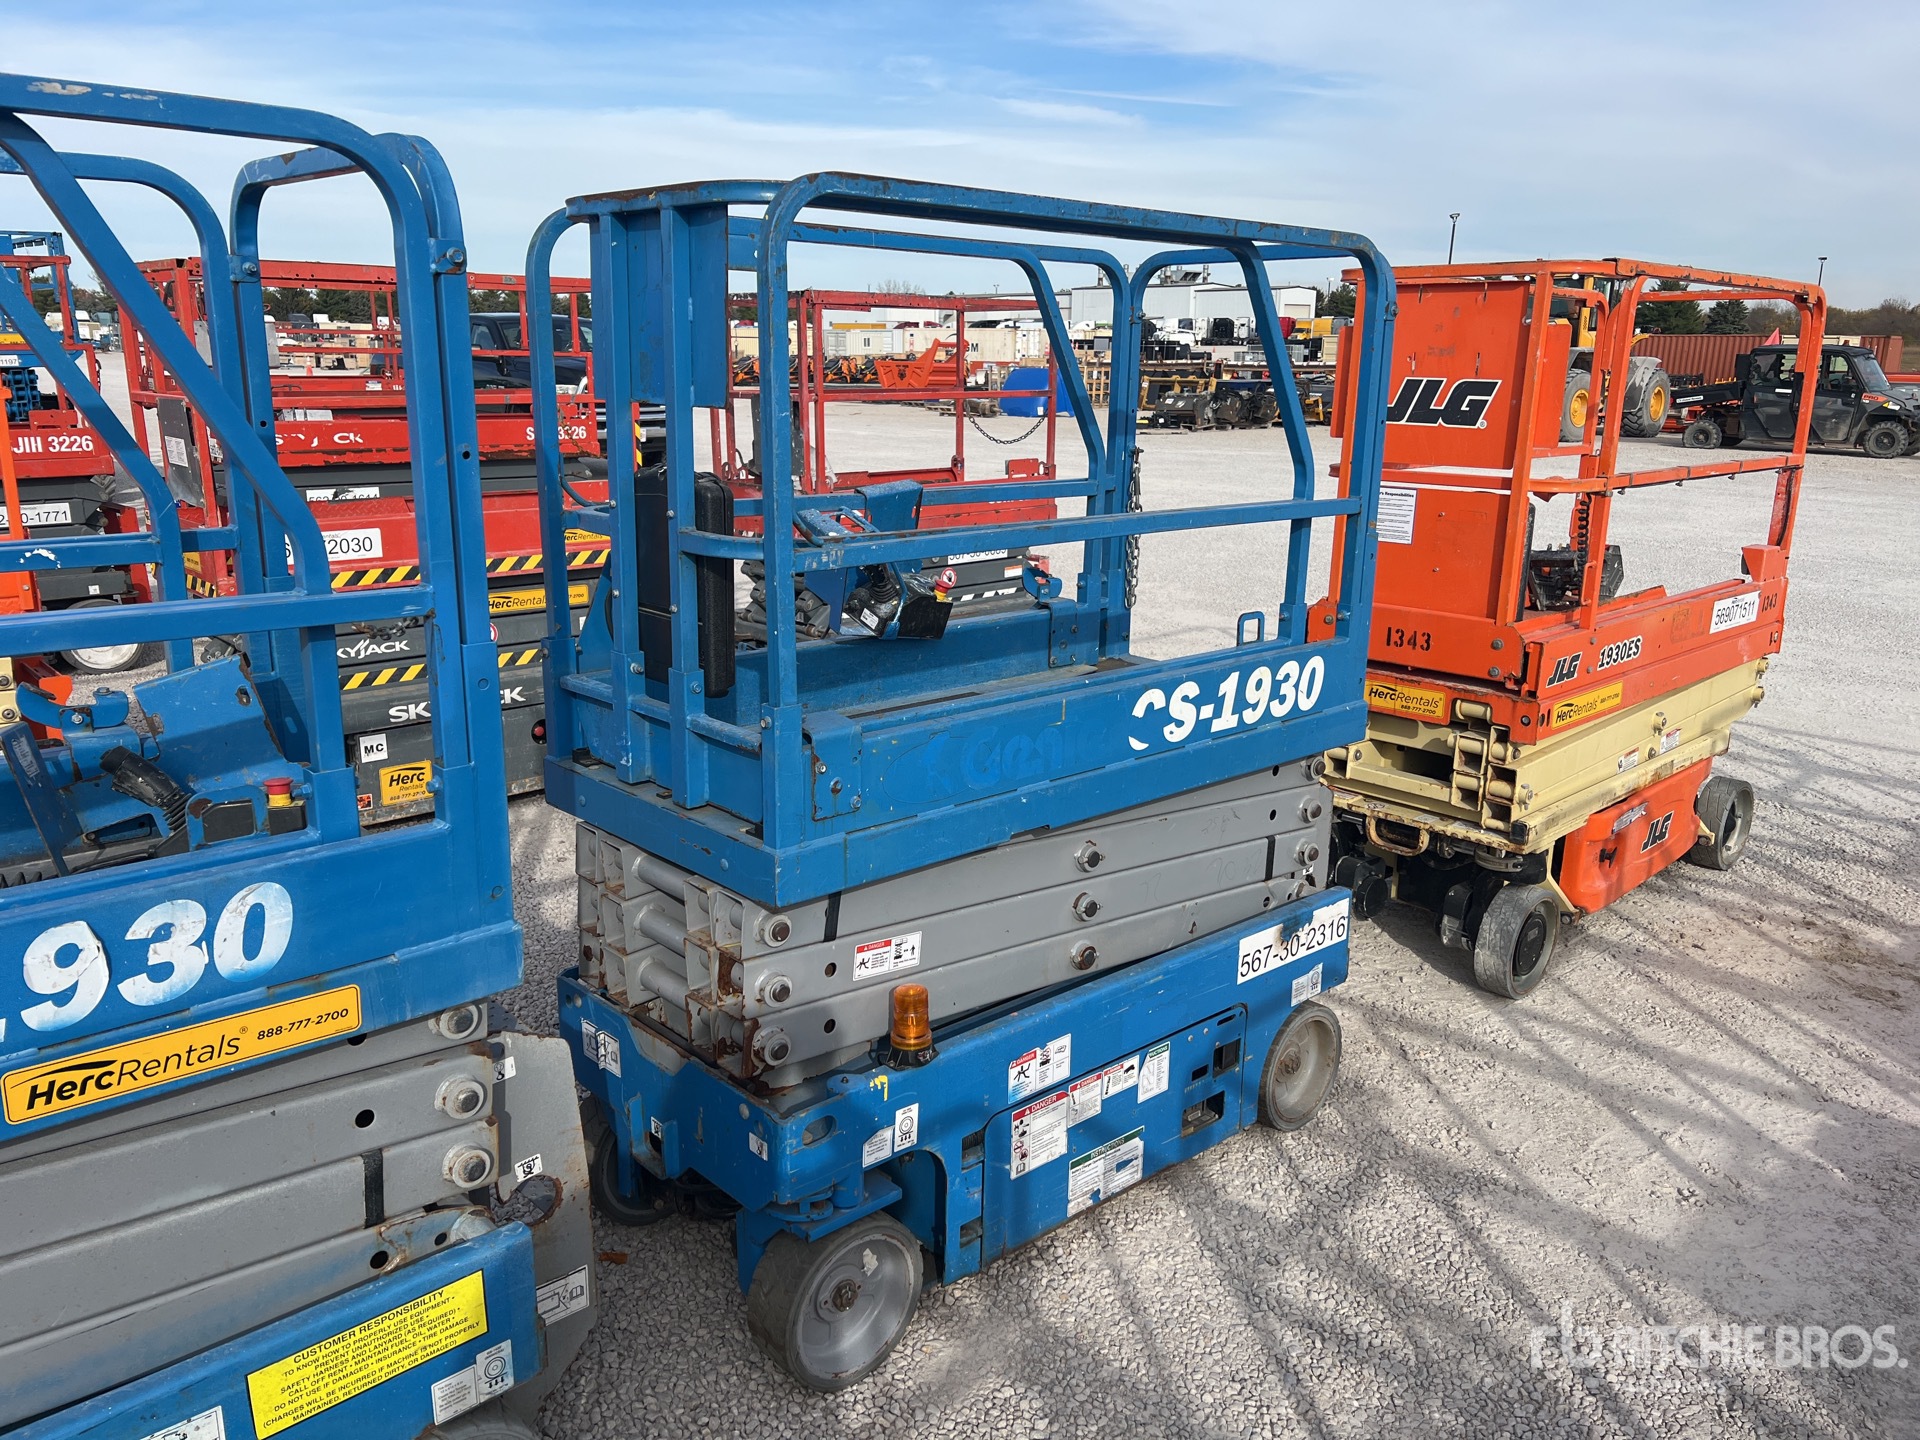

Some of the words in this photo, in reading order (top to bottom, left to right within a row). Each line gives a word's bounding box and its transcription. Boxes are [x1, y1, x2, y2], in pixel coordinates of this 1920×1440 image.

[1386, 377, 1501, 428] JLG
[48, 435, 94, 452] 3226
[488, 596, 546, 610] HercRental
[1714, 600, 1756, 626] 569071511
[1386, 627, 1432, 651] 1343
[1546, 652, 1582, 688] JLG
[1598, 636, 1642, 670] 1930ES
[388, 772, 426, 787] Herc
[1640, 811, 1674, 854] JLG
[0, 882, 293, 1042] 930
[1240, 916, 1346, 978] 567-30-2316
[257, 1008, 348, 1040] 888-777-2700
[1031, 1096, 1057, 1112] DANGER
[280, 1376, 310, 1394] SAFETY
[313, 1358, 350, 1378] HARNESS
[352, 1350, 366, 1361] AND
[368, 1334, 402, 1353] LANYARD
[404, 1327, 416, 1338] (AS
[418, 1308, 456, 1329] REQUIRED)
[284, 1370, 294, 1378] TO
[296, 1357, 320, 1372] KNOW
[322, 1348, 340, 1360] HOW
[342, 1343, 351, 1352] TO
[354, 1324, 392, 1346] PROPERLY
[394, 1317, 408, 1327] USE
[410, 1298, 450, 1320] EQUIPMENT
[294, 1330, 356, 1364] CUSTOMER
[359, 1290, 444, 1334] RESPONSIBILITY
[314, 1350, 349, 1370] PREVENT
[352, 1324, 408, 1356] UNAUTHORIZED
[410, 1316, 424, 1326] USE
[263, 1405, 305, 1428] (CHARGES
[306, 1396, 324, 1408] WILL
[326, 1389, 336, 1398] BE
[338, 1370, 376, 1392] INCURRED
[378, 1364, 385, 1372] IF
[386, 1350, 420, 1369] MACHINE
[428, 1339, 443, 1350] NOT
[444, 1321, 480, 1342] PROPERLY
[274, 1402, 286, 1412] DO
[288, 1394, 304, 1406] NOT
[306, 1386, 322, 1397] USE
[332, 1364, 370, 1384] DAMAGED
[376, 1342, 418, 1364] INSURANCE
[423, 1332, 438, 1342] TIRE
[440, 1316, 470, 1334] DAMAGE
[288, 1384, 308, 1397] CALL
[310, 1376, 326, 1386] OFF
[328, 1366, 348, 1378] RENT
[354, 1346, 388, 1366] MAINTAIN
[427, 1318, 451, 1332] WATER
[342, 1374, 382, 1398] RETURNED
[408, 1357, 420, 1366] OR
[420, 1340, 457, 1360] DAMAGED)
